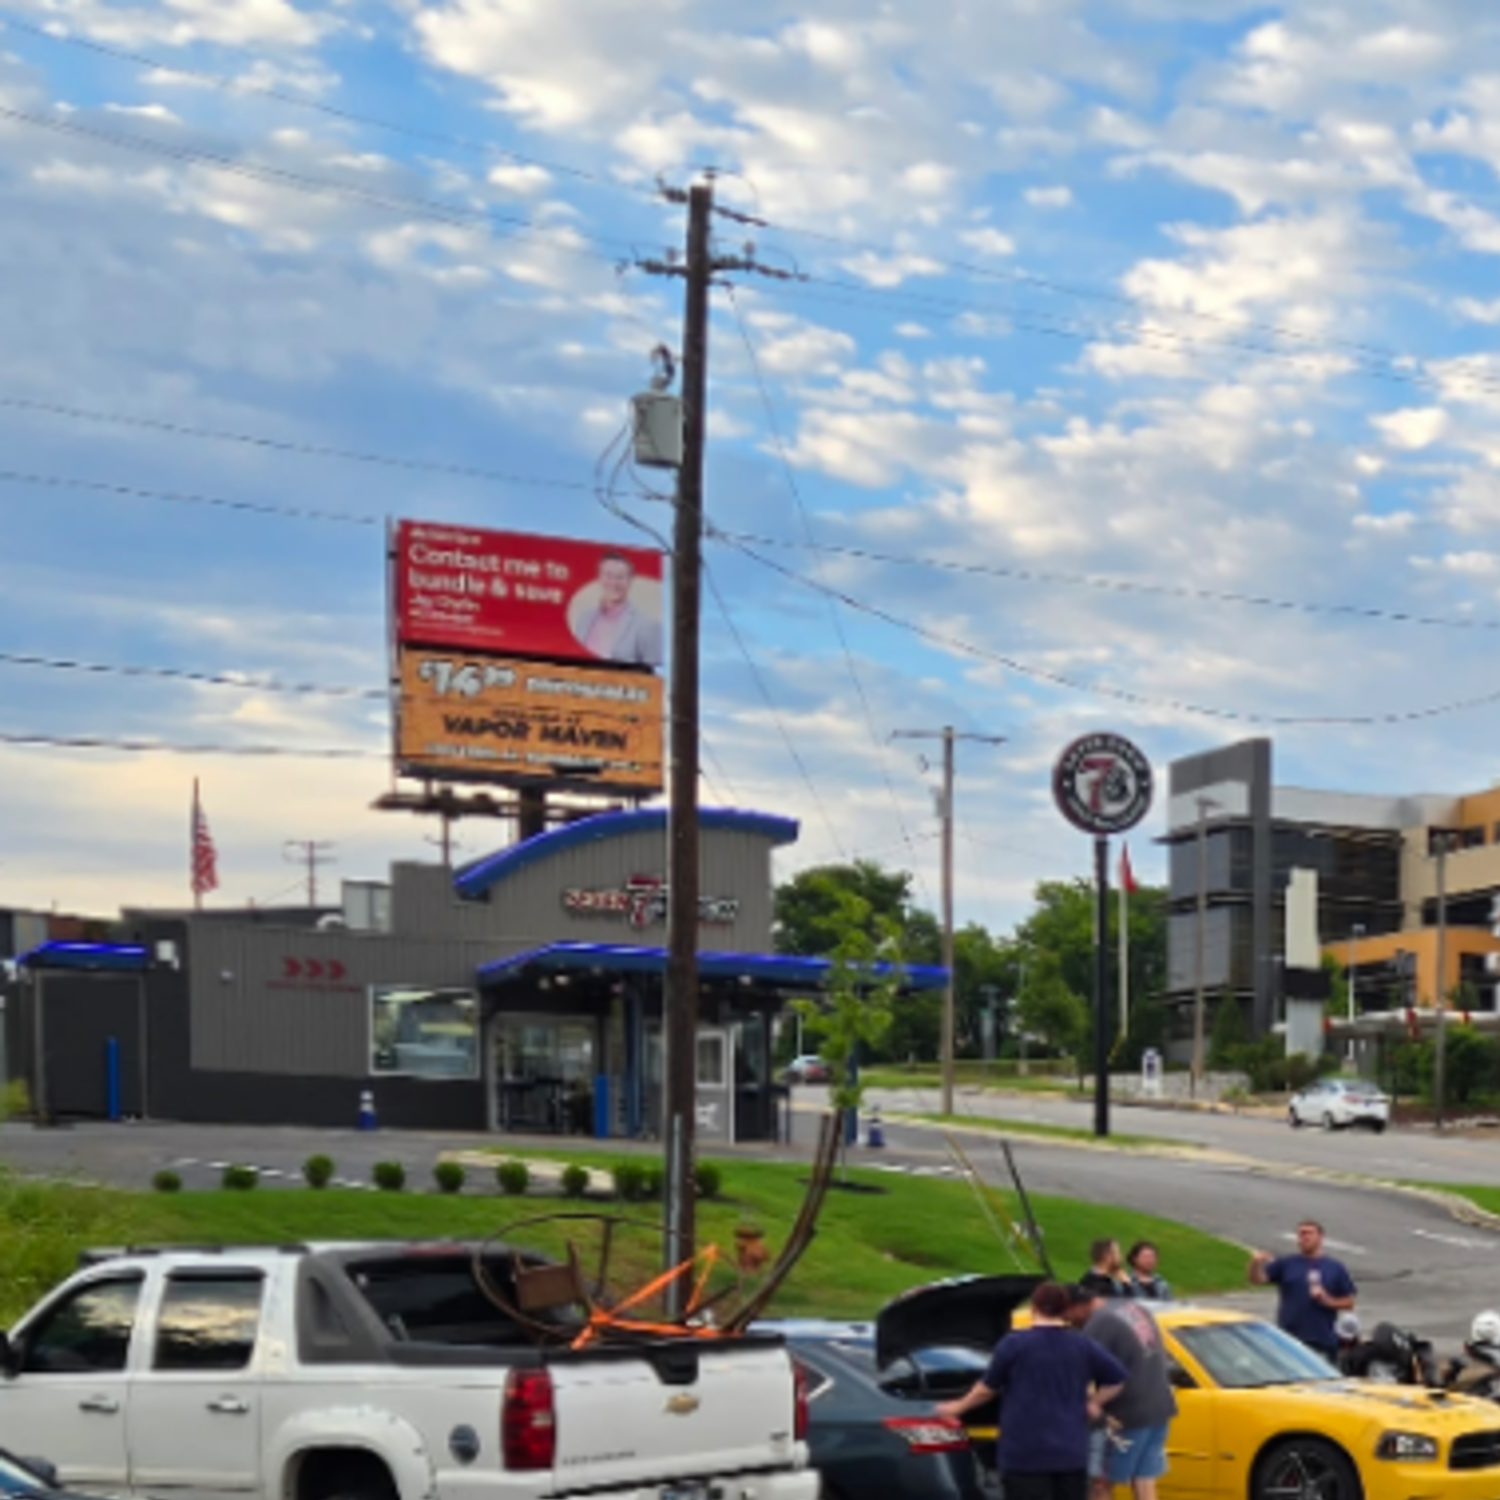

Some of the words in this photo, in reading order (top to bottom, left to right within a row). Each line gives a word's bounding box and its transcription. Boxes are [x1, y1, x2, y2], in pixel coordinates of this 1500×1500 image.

[408, 543, 499, 572] Contact
[504, 558, 541, 578] me
[546, 561, 569, 580] to
[408, 567, 486, 597] bundle
[443, 714, 530, 739] VAPOR
[540, 724, 628, 749] MAVEN
